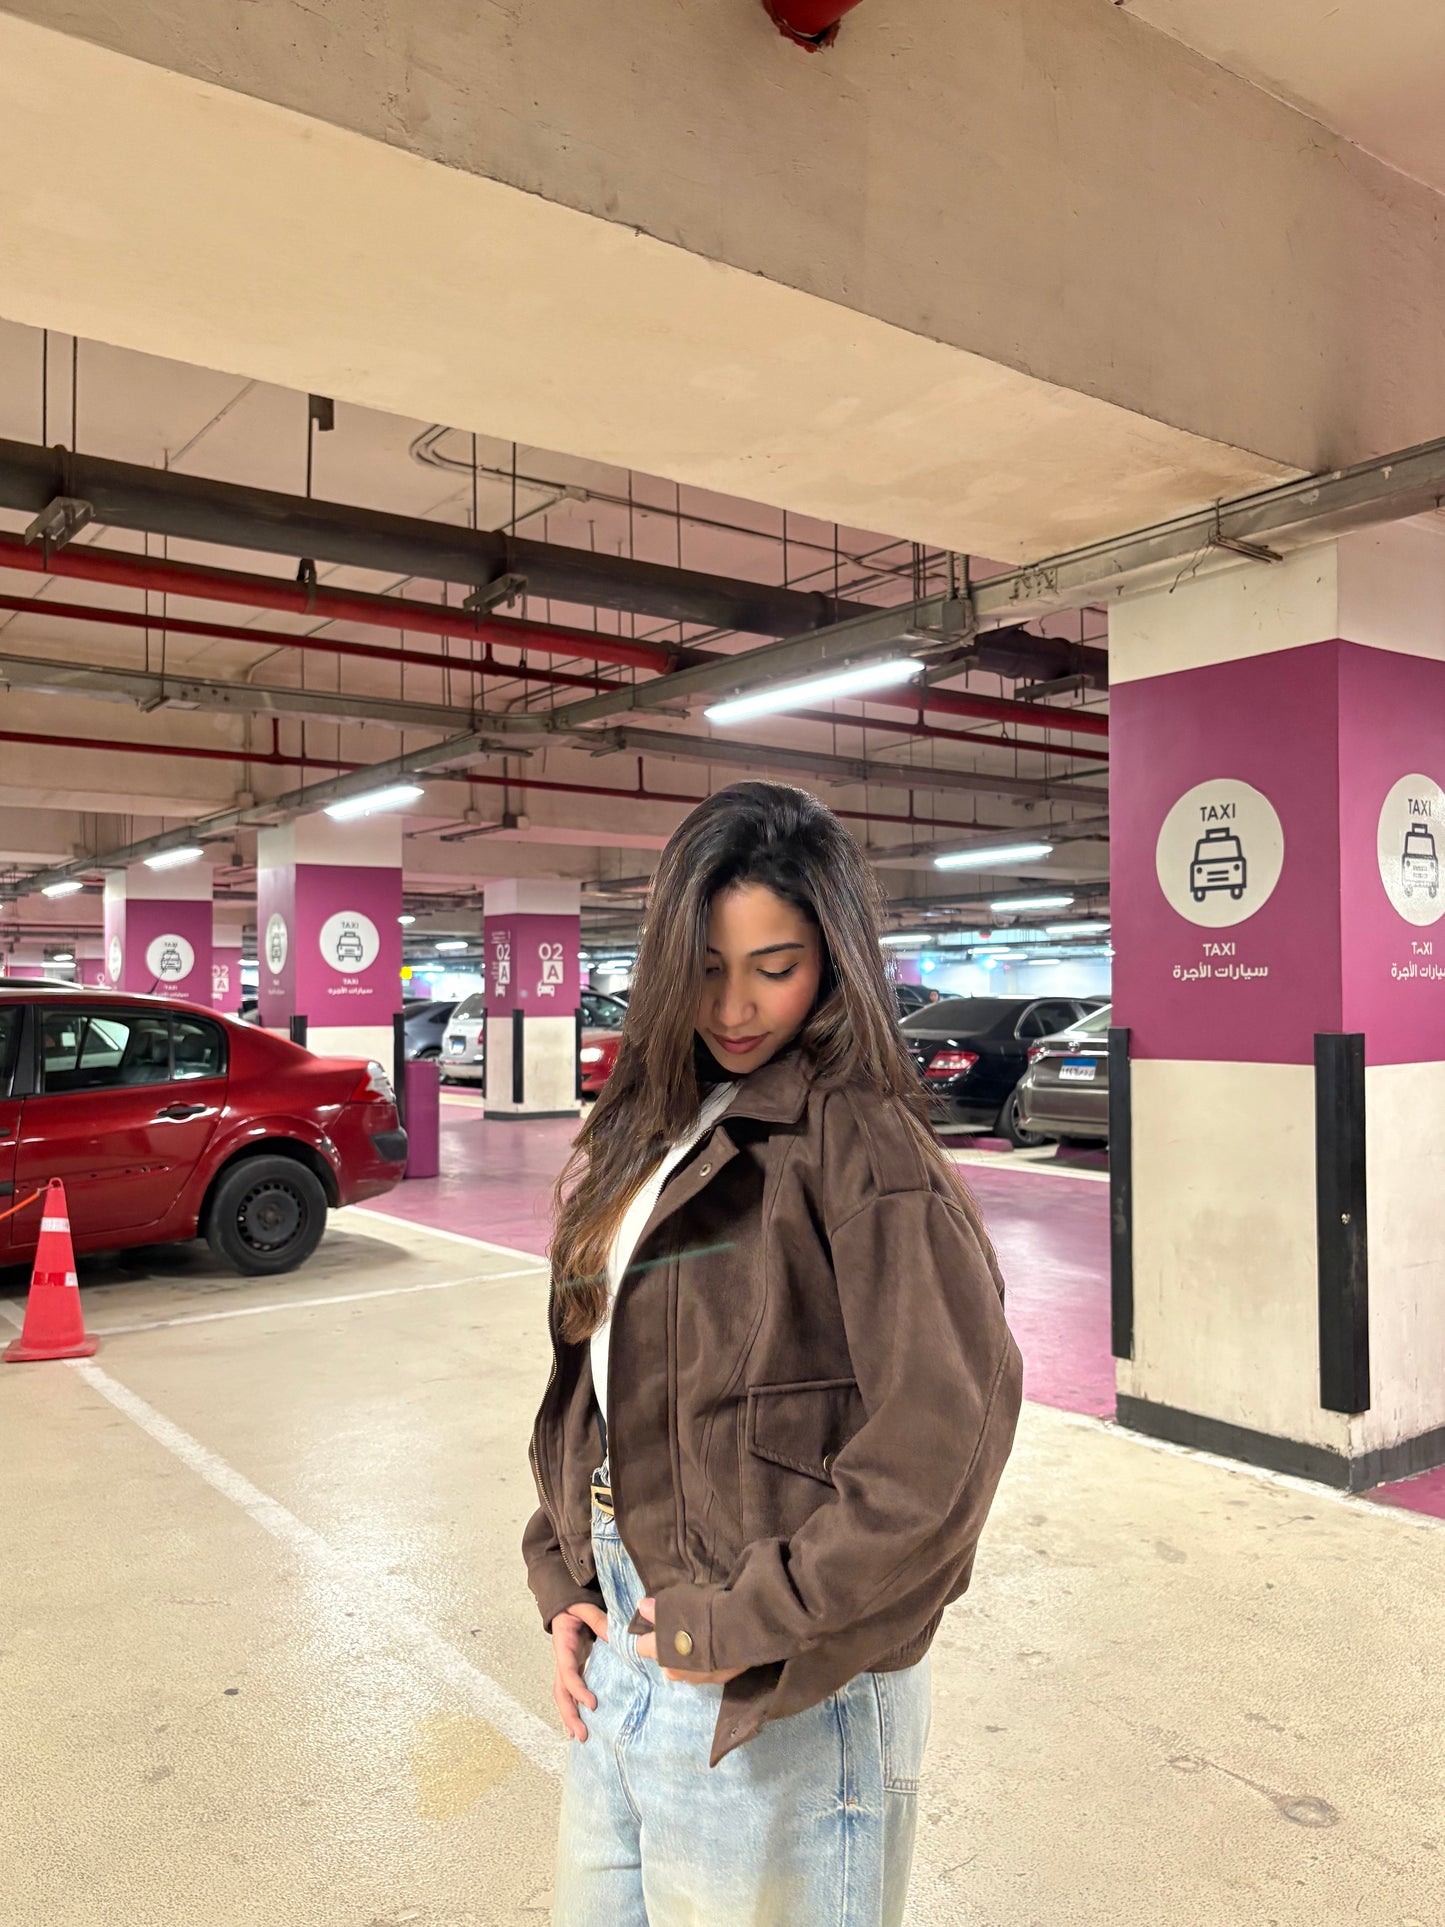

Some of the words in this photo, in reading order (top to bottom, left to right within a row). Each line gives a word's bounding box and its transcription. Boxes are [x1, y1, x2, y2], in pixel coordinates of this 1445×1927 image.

[1200, 802, 1236, 822] TAXI
[1408, 798, 1431, 817] TAXI
[341, 921, 359, 930] TAXI
[496, 943, 511, 960] 02
[538, 942, 564, 960] 02
[1202, 942, 1236, 957] TAXI
[500, 964, 509, 981] A
[546, 964, 560, 980] A
[1173, 961, 1212, 982] الأجرة
[1215, 963, 1269, 981] سيارات
[1391, 960, 1418, 981] الأجرة
